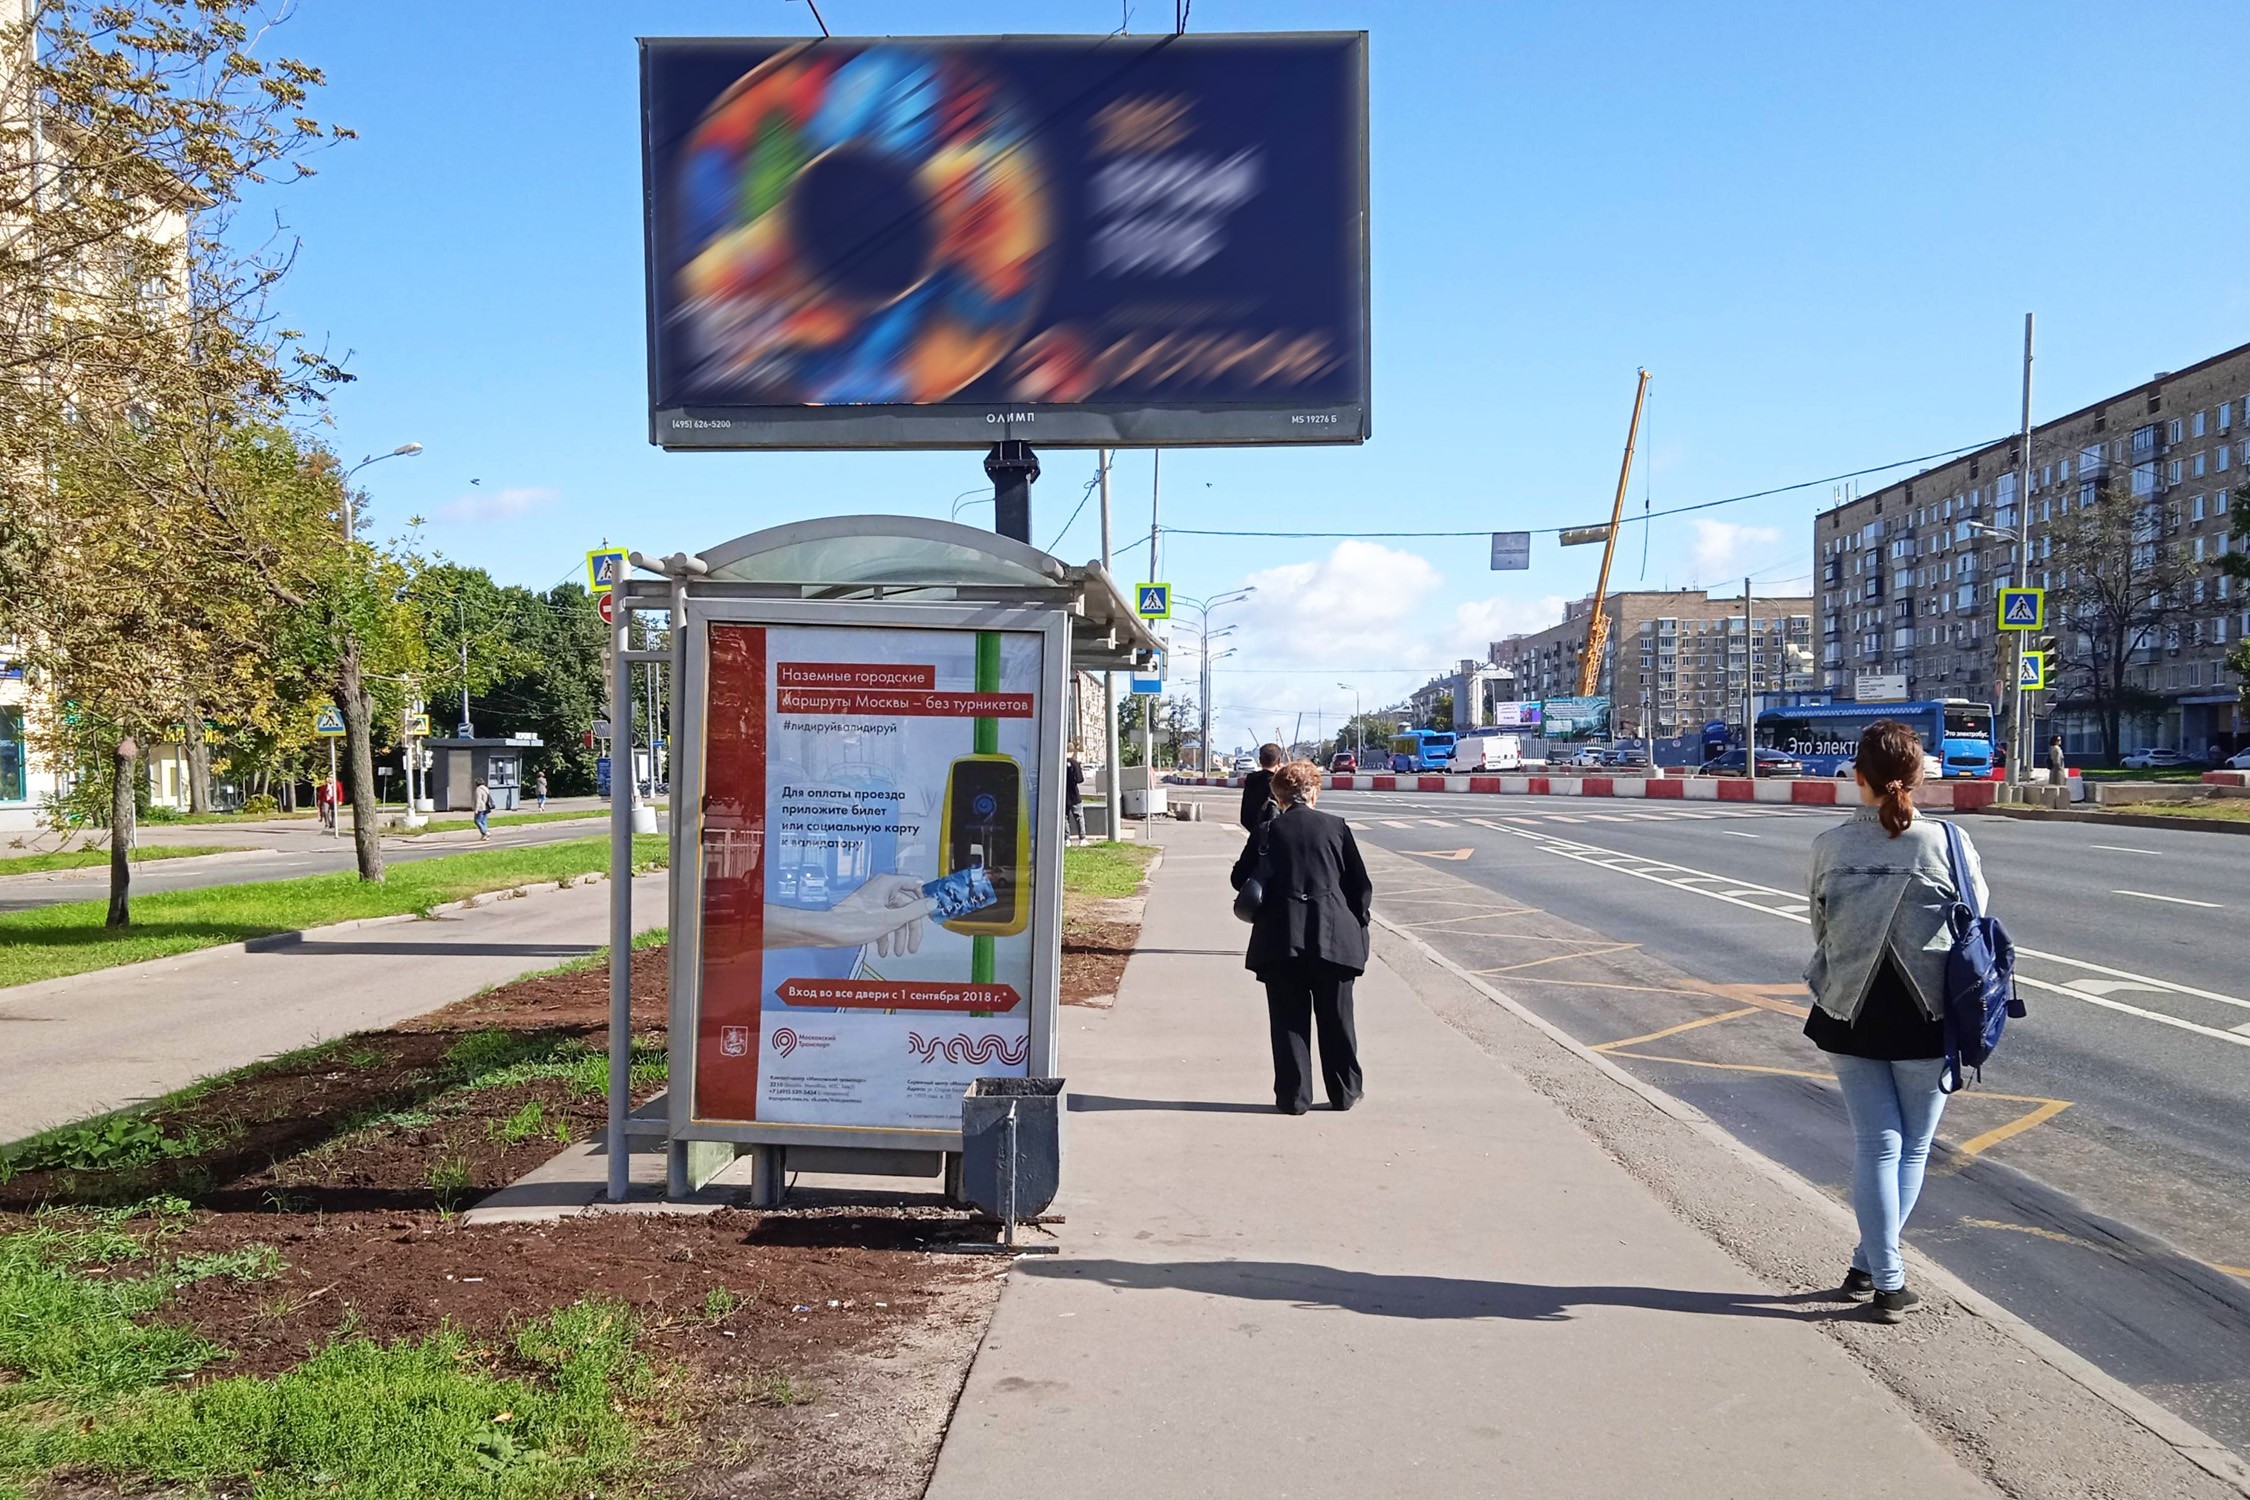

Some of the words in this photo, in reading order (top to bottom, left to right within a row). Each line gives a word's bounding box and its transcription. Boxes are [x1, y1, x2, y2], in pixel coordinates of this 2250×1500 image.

[672, 419, 692, 429] (495)
[693, 420, 731, 429] 626-5200
[986, 412, 1035, 423] ОЛИМП
[1306, 415, 1329, 423] 19276
[782, 667, 851, 682] Наземные
[855, 673, 926, 686] городские
[855, 695, 909, 709] Москвы
[925, 695, 950, 709] без
[953, 700, 1029, 713] турникетов
[783, 720, 898, 735] #лидируйвалидируй
[1787, 736, 1813, 755] Это
[782, 786, 804, 799] Для
[807, 789, 851, 799] оплаты
[854, 790, 906, 801] проезда
[782, 805, 849, 816] приложите
[851, 804, 887, 816] билет
[782, 822, 804, 831] или
[806, 823, 882, 835] социальную
[884, 825, 920, 836] карту
[788, 986, 818, 999] Вход
[819, 989, 833, 998] во
[835, 990, 853, 998] все
[855, 991, 889, 1001] двери
[891, 991, 898, 1000] с
[901, 989, 906, 999] 1
[910, 990, 960, 1003] сентября
[962, 991, 992, 1002] 2018
